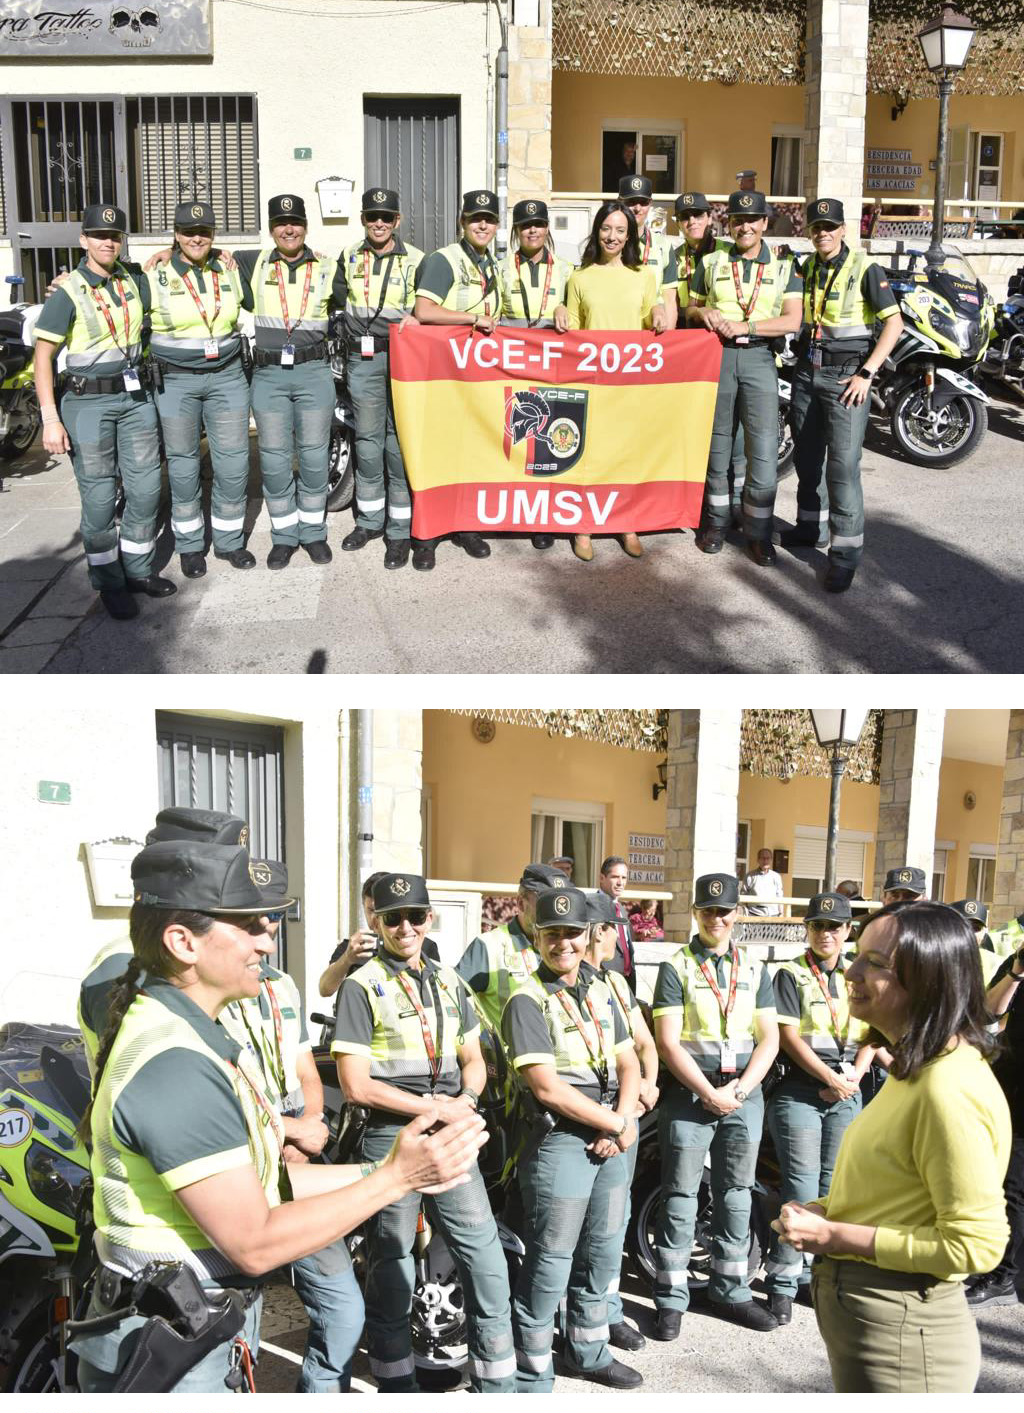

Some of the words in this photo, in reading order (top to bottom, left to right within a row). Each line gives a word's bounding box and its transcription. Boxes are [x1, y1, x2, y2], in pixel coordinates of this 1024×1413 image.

[300, 149, 306, 158] 7
[867, 151, 911, 161] RESIDENCIA
[867, 165, 900, 175] TERCERA
[903, 166, 922, 175] EDAD
[866, 178, 881, 188] LAS
[884, 179, 915, 189] ACACIAS
[918, 296, 930, 304] 203
[448, 337, 565, 370] VCE-F
[576, 342, 665, 373] 2023
[538, 390, 585, 401] VCE-F
[476, 489, 620, 526] UMSV
[48, 785, 59, 799] 7
[628, 853, 661, 865] TERCERA
[628, 871, 642, 881] LAS
